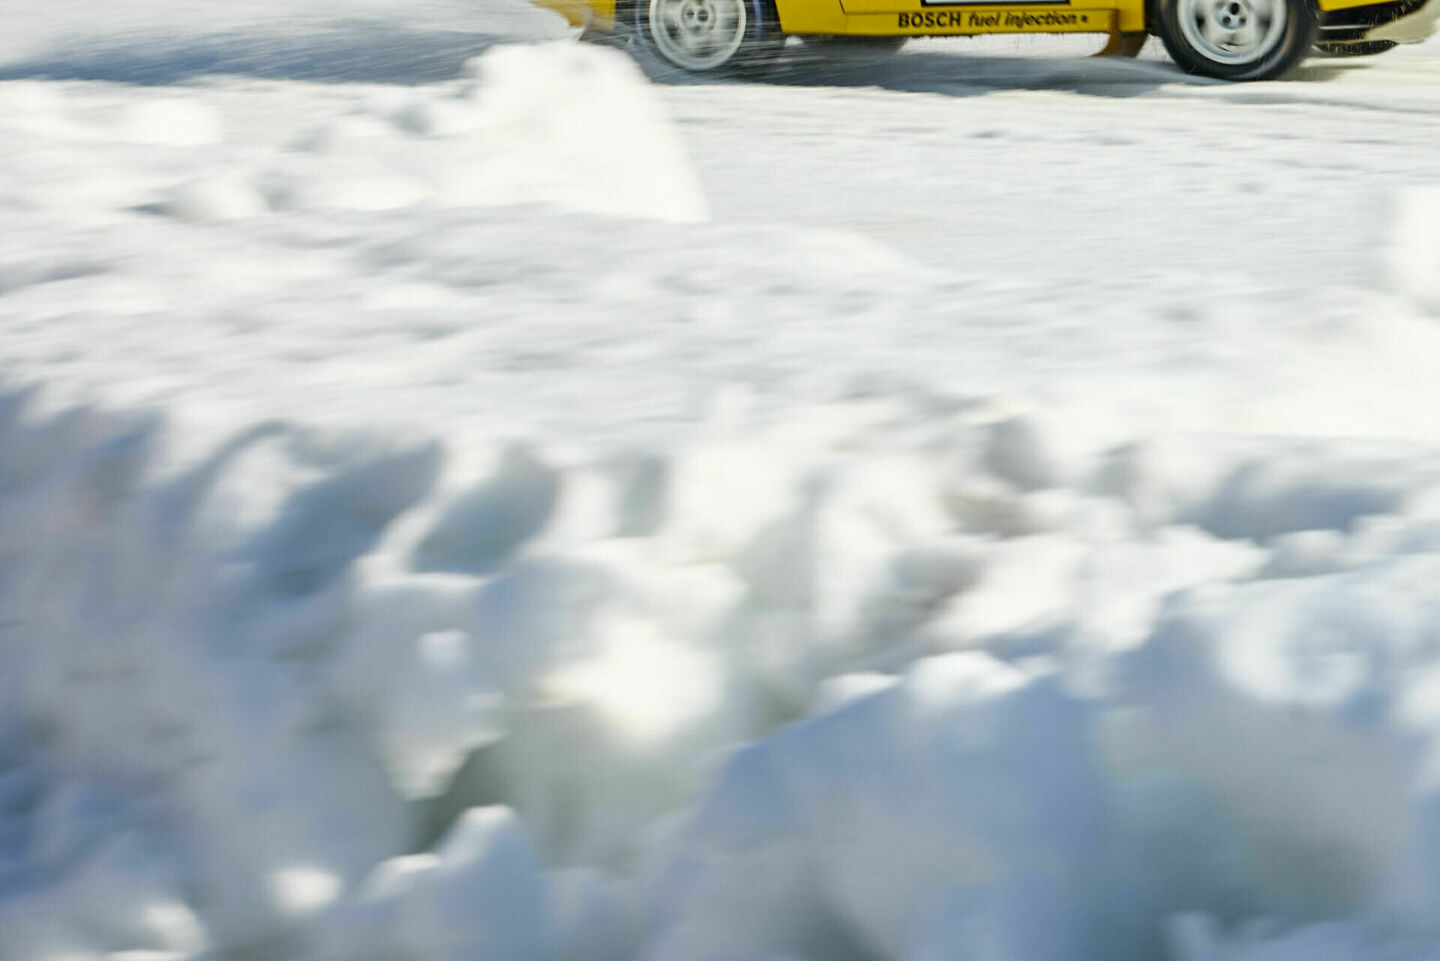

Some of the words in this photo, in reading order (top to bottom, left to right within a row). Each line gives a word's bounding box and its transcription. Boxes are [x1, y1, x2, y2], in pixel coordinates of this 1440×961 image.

[898, 12, 962, 28] BOSCH
[968, 12, 1002, 27] fuel
[1004, 11, 1078, 28] injection
